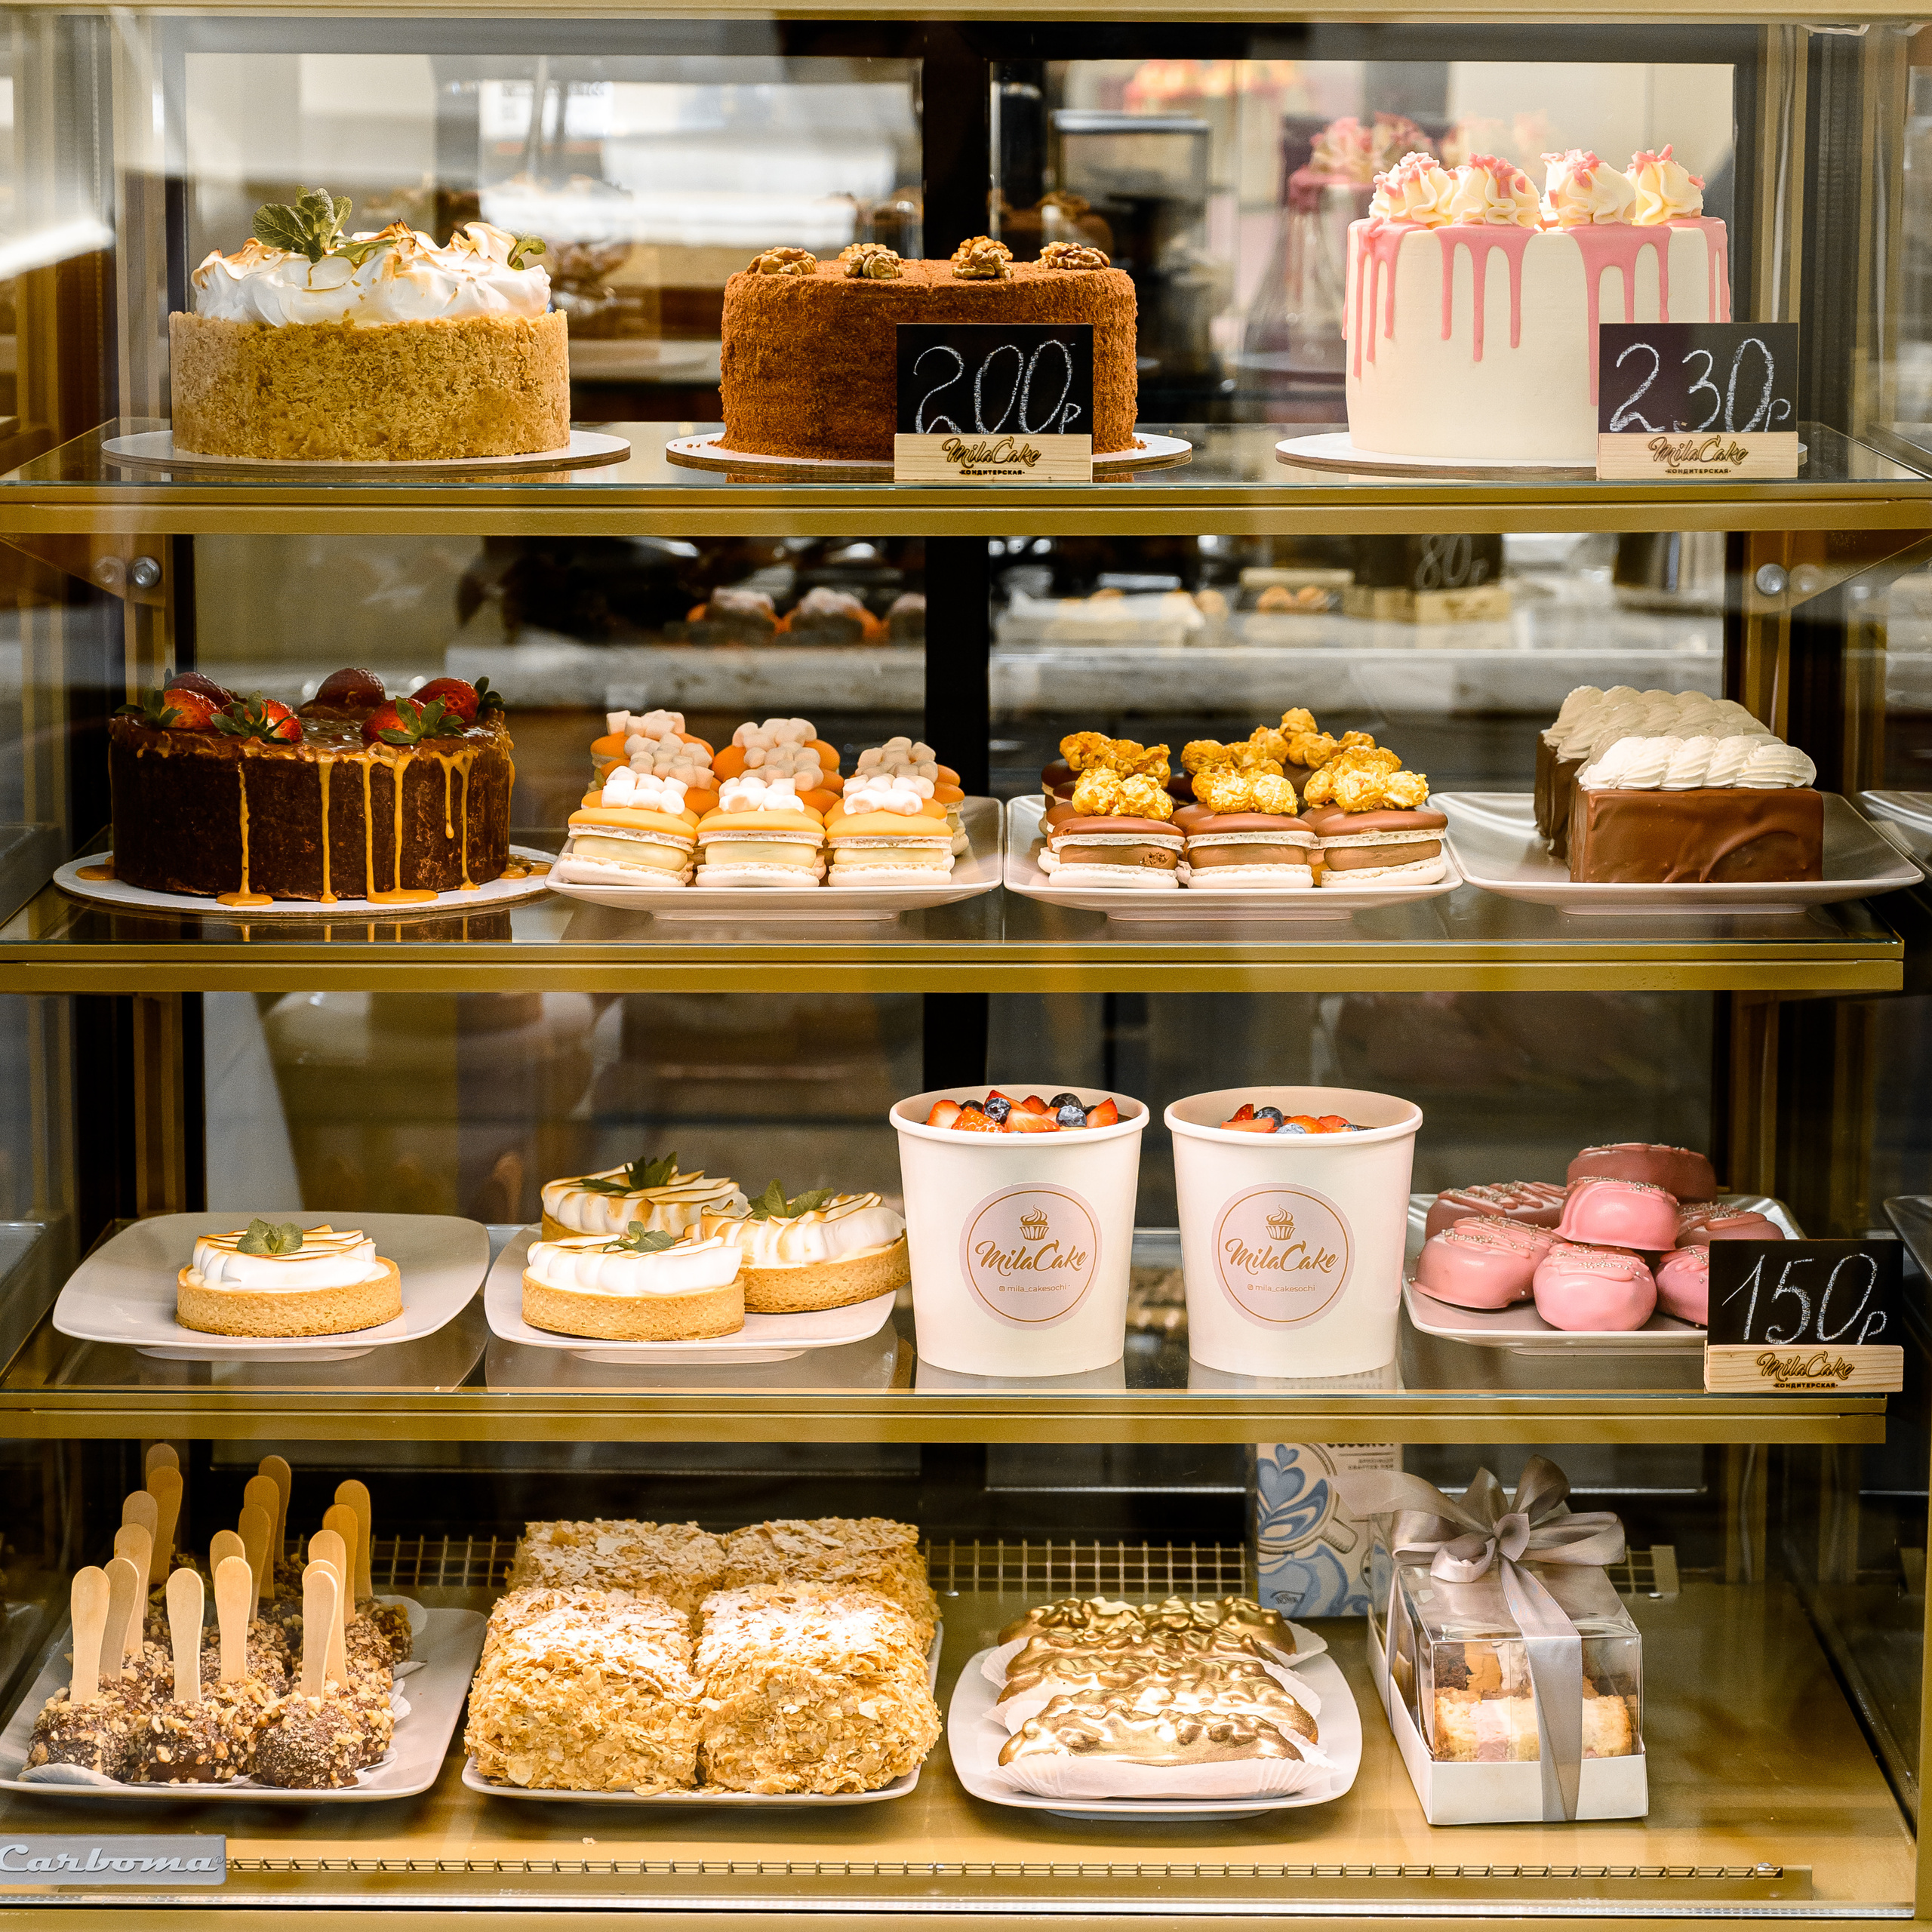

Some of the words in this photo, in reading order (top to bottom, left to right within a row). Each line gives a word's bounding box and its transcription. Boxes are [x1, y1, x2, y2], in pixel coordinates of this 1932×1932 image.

[942, 436, 1042, 468] MilaCake
[1648, 435, 1749, 467] MilaCake
[974, 1239, 1089, 1277] MilaCake
[1224, 1238, 1339, 1275] MilaCake
[1007, 1284, 1067, 1293] mila_cakesochi
[1255, 1284, 1315, 1293] mila_cakesochi
[1756, 1351, 1855, 1381] MilaCake
